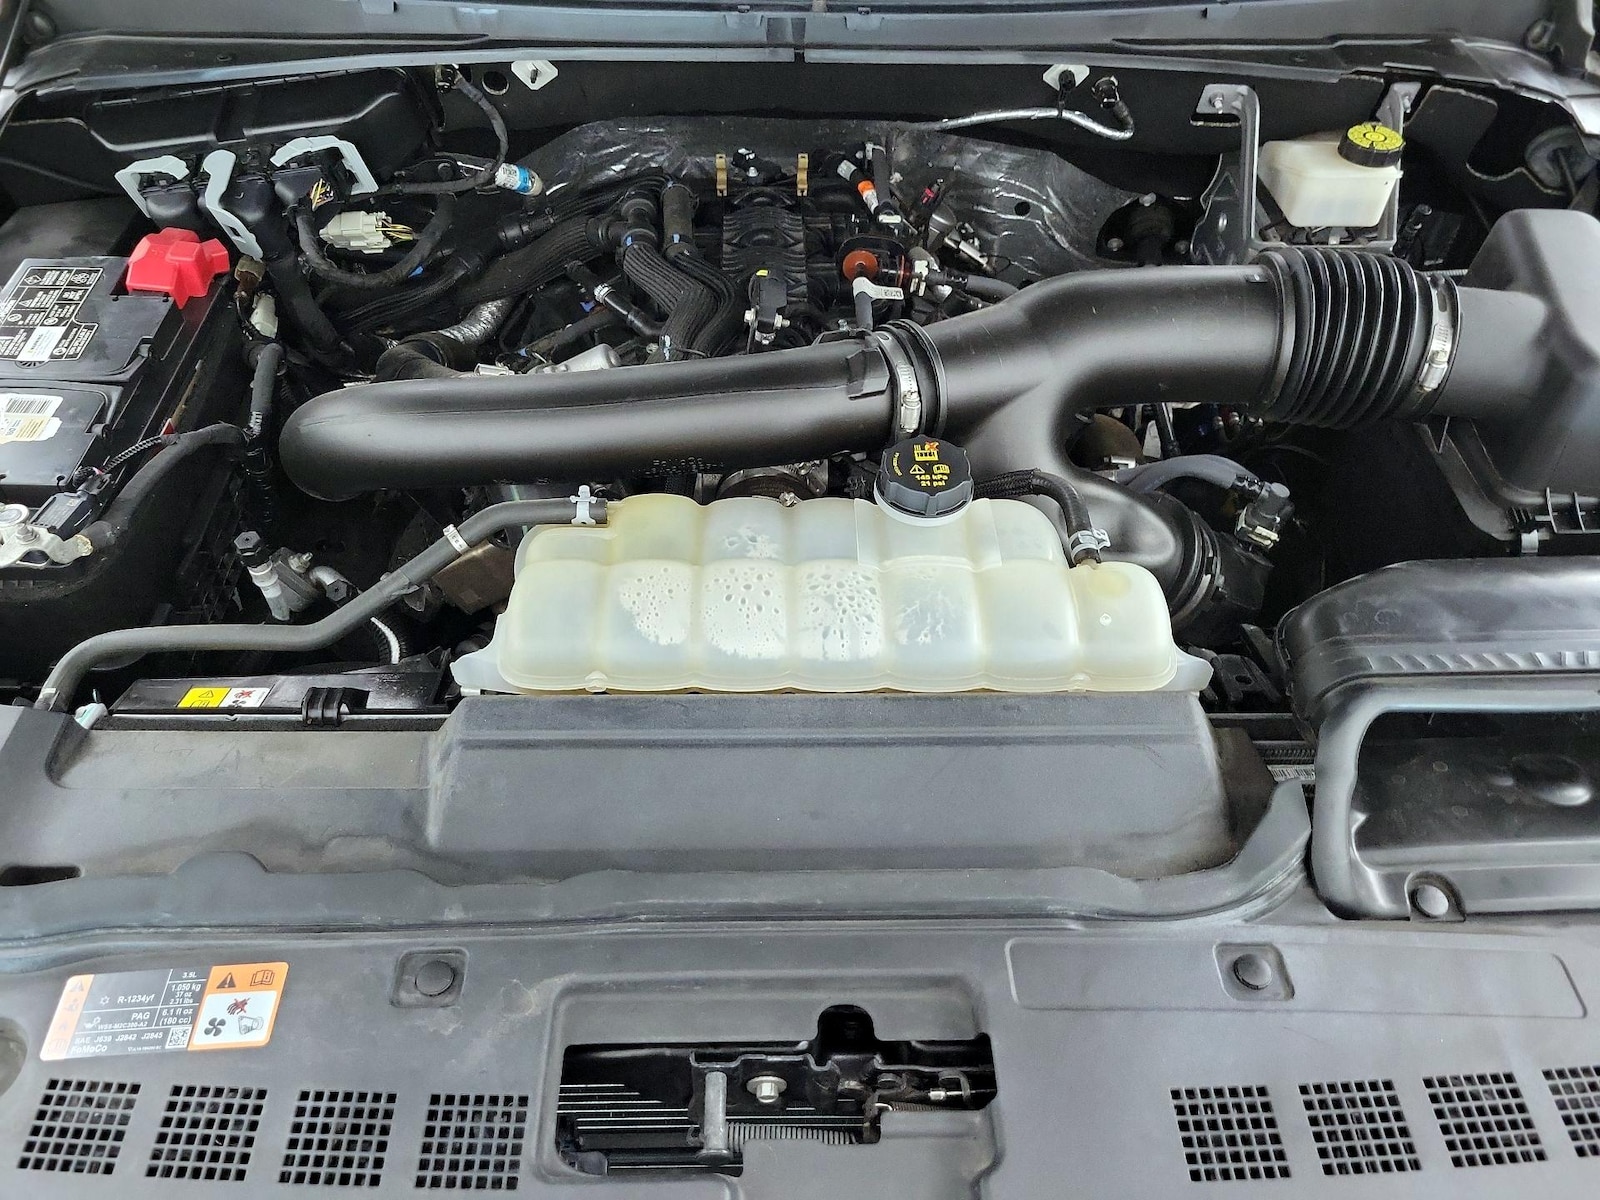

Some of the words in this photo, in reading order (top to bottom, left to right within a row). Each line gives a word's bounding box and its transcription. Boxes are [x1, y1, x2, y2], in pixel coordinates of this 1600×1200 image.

[171, 984, 190, 992] 1.050
[191, 983, 201, 992] kg
[117, 994, 155, 1004] R-1234yf
[131, 1012, 150, 1020] PAG
[162, 1008, 173, 1016] 6.1
[178, 1016, 192, 1025] cc)
